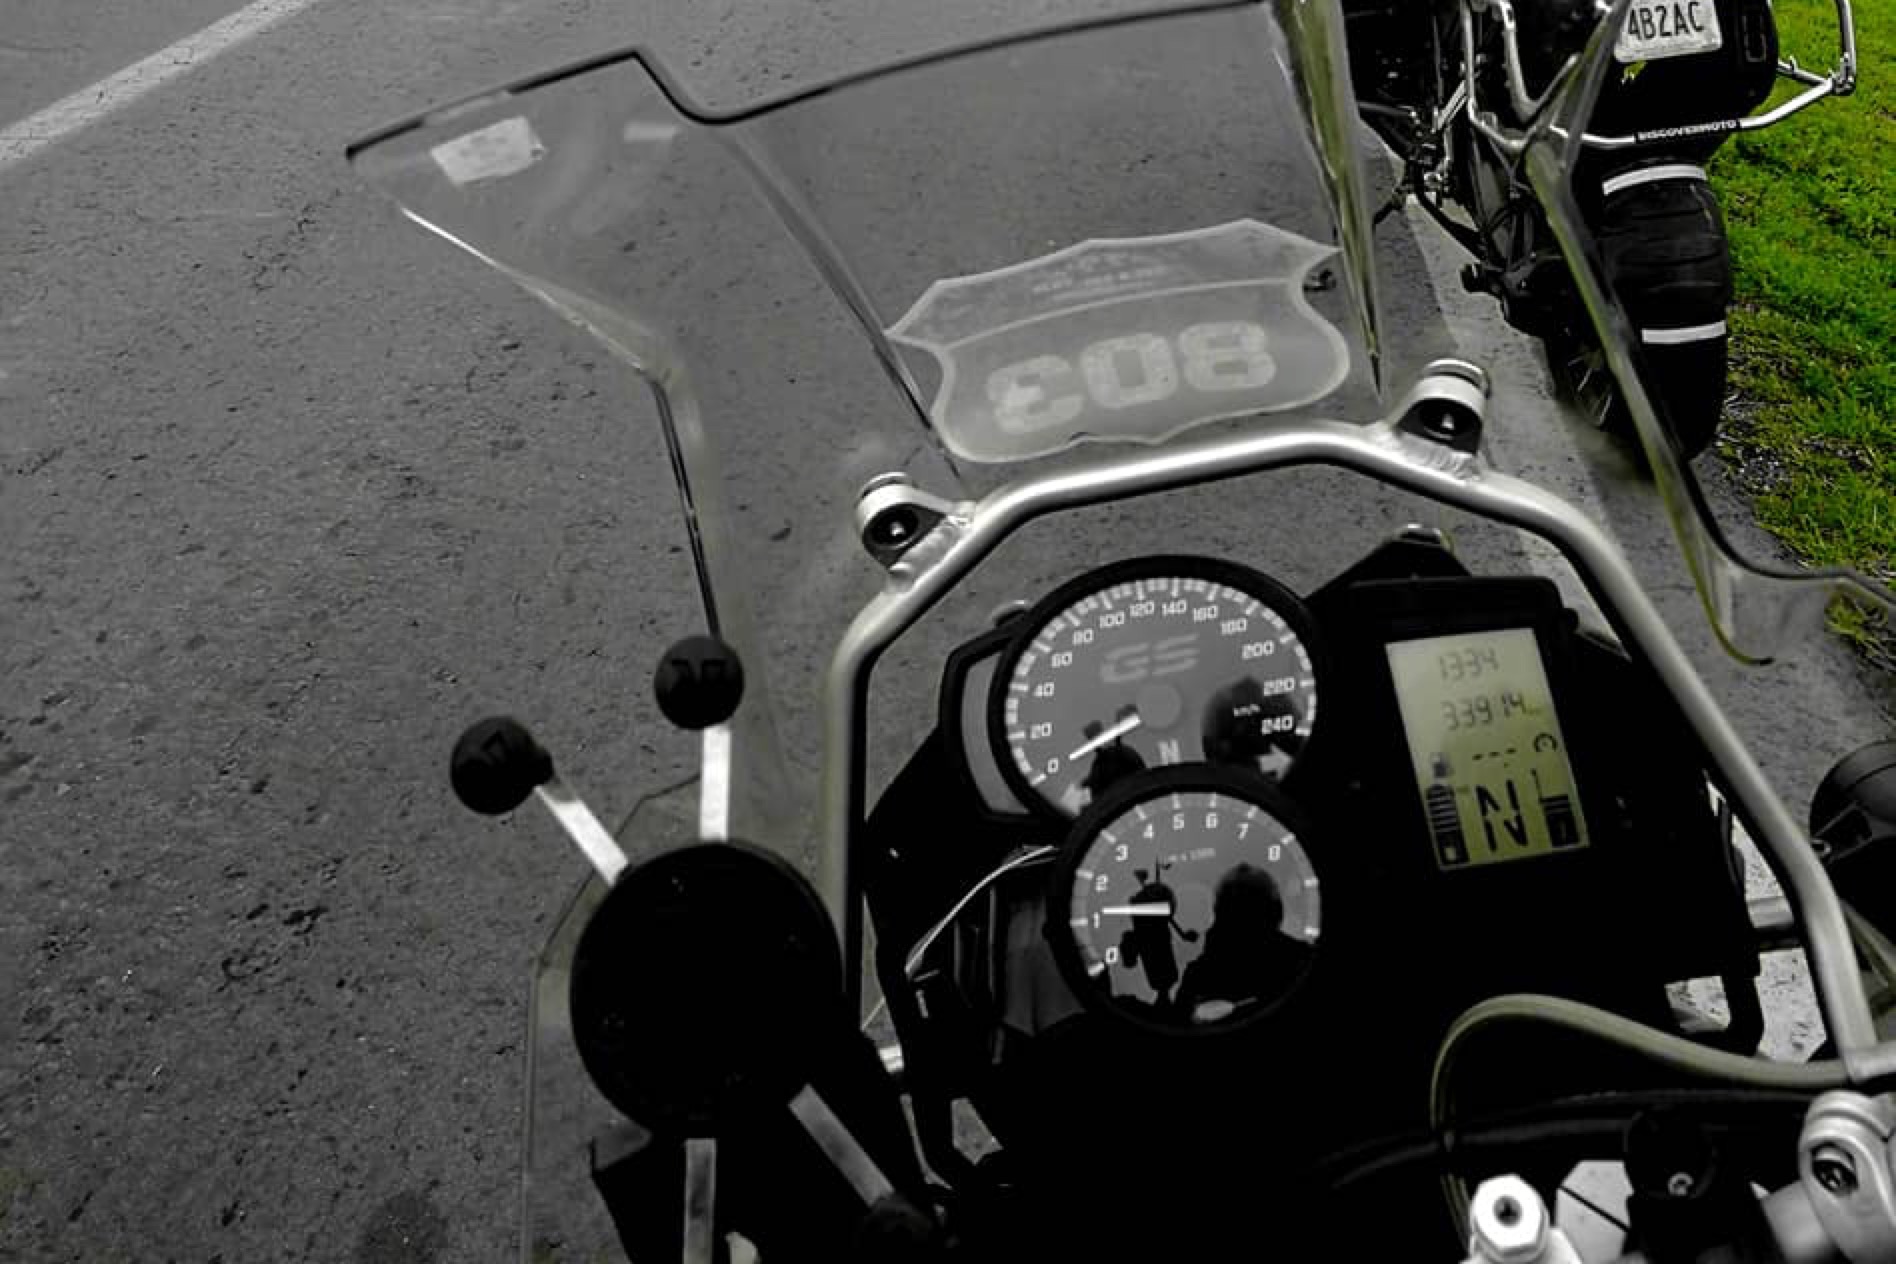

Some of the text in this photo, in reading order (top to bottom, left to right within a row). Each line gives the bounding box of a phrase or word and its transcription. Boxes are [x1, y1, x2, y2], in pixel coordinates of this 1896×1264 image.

[1627, 1, 1705, 41] 4B2AC
[1637, 119, 1737, 140] DISCOVERMOTO
[1129, 601, 1155, 617] 120
[1161, 599, 1187, 616] 140
[1099, 612, 1125, 628] 100
[1100, 634, 1199, 683] GS
[1242, 640, 1275, 660] 200
[1033, 681, 1055, 697] 40
[1263, 677, 1295, 696] 220
[1030, 722, 1052, 740] 20
[1261, 715, 1293, 735] 240
[1047, 757, 1059, 774] 0
[1172, 814, 1185, 831] 5
[1205, 813, 1218, 829] 6
[1143, 823, 1154, 839] 4
[1237, 822, 1250, 839] 7
[1115, 844, 1129, 862] 3
[1095, 874, 1109, 892] 2
[1092, 911, 1100, 929] 1
[1105, 946, 1119, 965] 0
